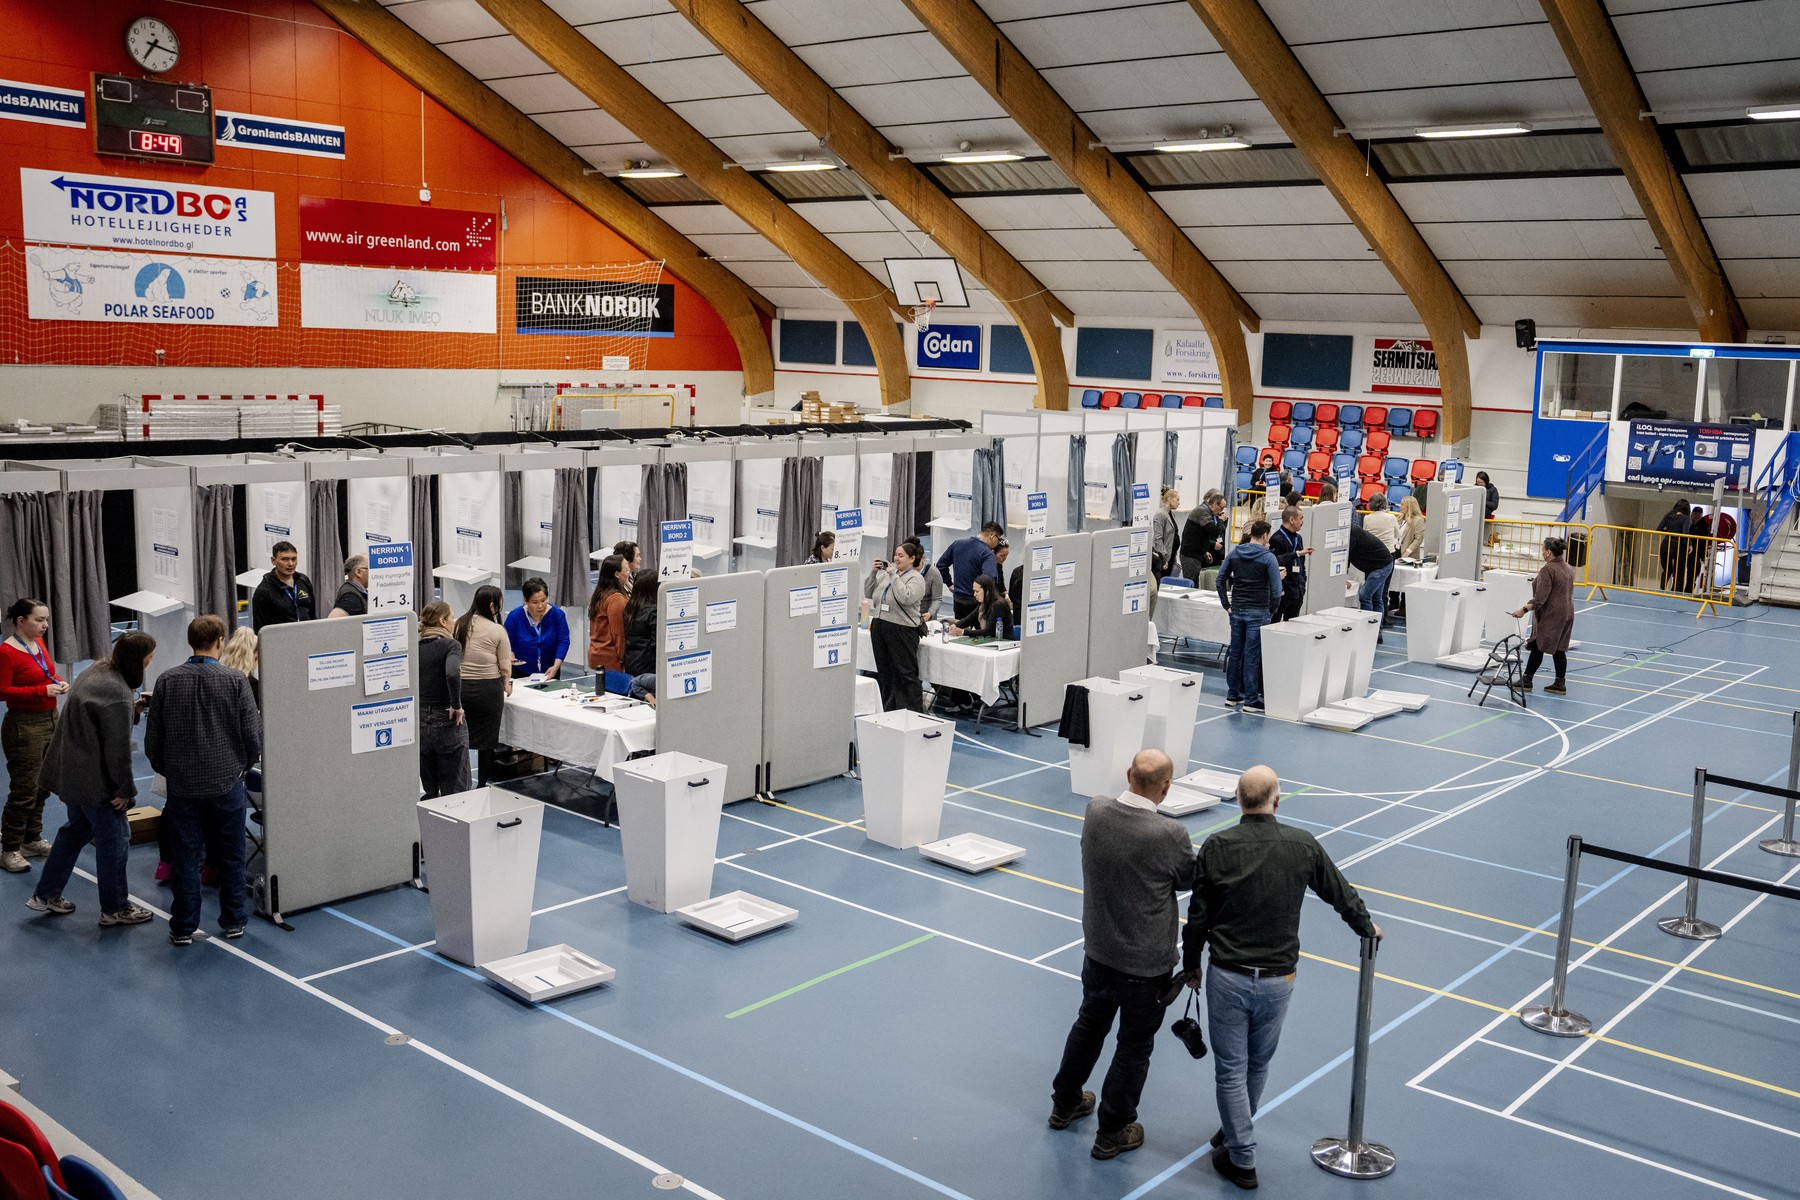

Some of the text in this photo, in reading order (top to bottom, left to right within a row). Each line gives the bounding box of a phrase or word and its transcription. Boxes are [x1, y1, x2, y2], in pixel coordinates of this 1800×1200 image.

[141, 133, 180, 153] 8:49
[237, 125, 341, 147] GrønlandsBANKEN
[70, 187, 232, 220] NORDBO
[71, 215, 232, 237] HOTELLEJLIGHEDER
[112, 236, 194, 250] www.hotelnordbo.gl
[104, 303, 215, 320] POLAR SEAFOOD
[365, 309, 441, 326] NUUK IMEQ
[923, 331, 973, 359] Codan
[1176, 340, 1205, 348] Kalaallit
[1175, 348, 1211, 360] Forsikring
[1373, 350, 1438, 370] SERMITSIA
[371, 546, 404, 555] NERRIVIK
[834, 550, 841, 559] 8.
[850, 548, 859, 557] 11.
[377, 557, 398, 565] BORD
[661, 566, 670, 576] 4.
[682, 564, 689, 574] 7.
[373, 596, 383, 608] 1.
[399, 594, 410, 605] 3.
[374, 719, 397, 727] VENLIGST
